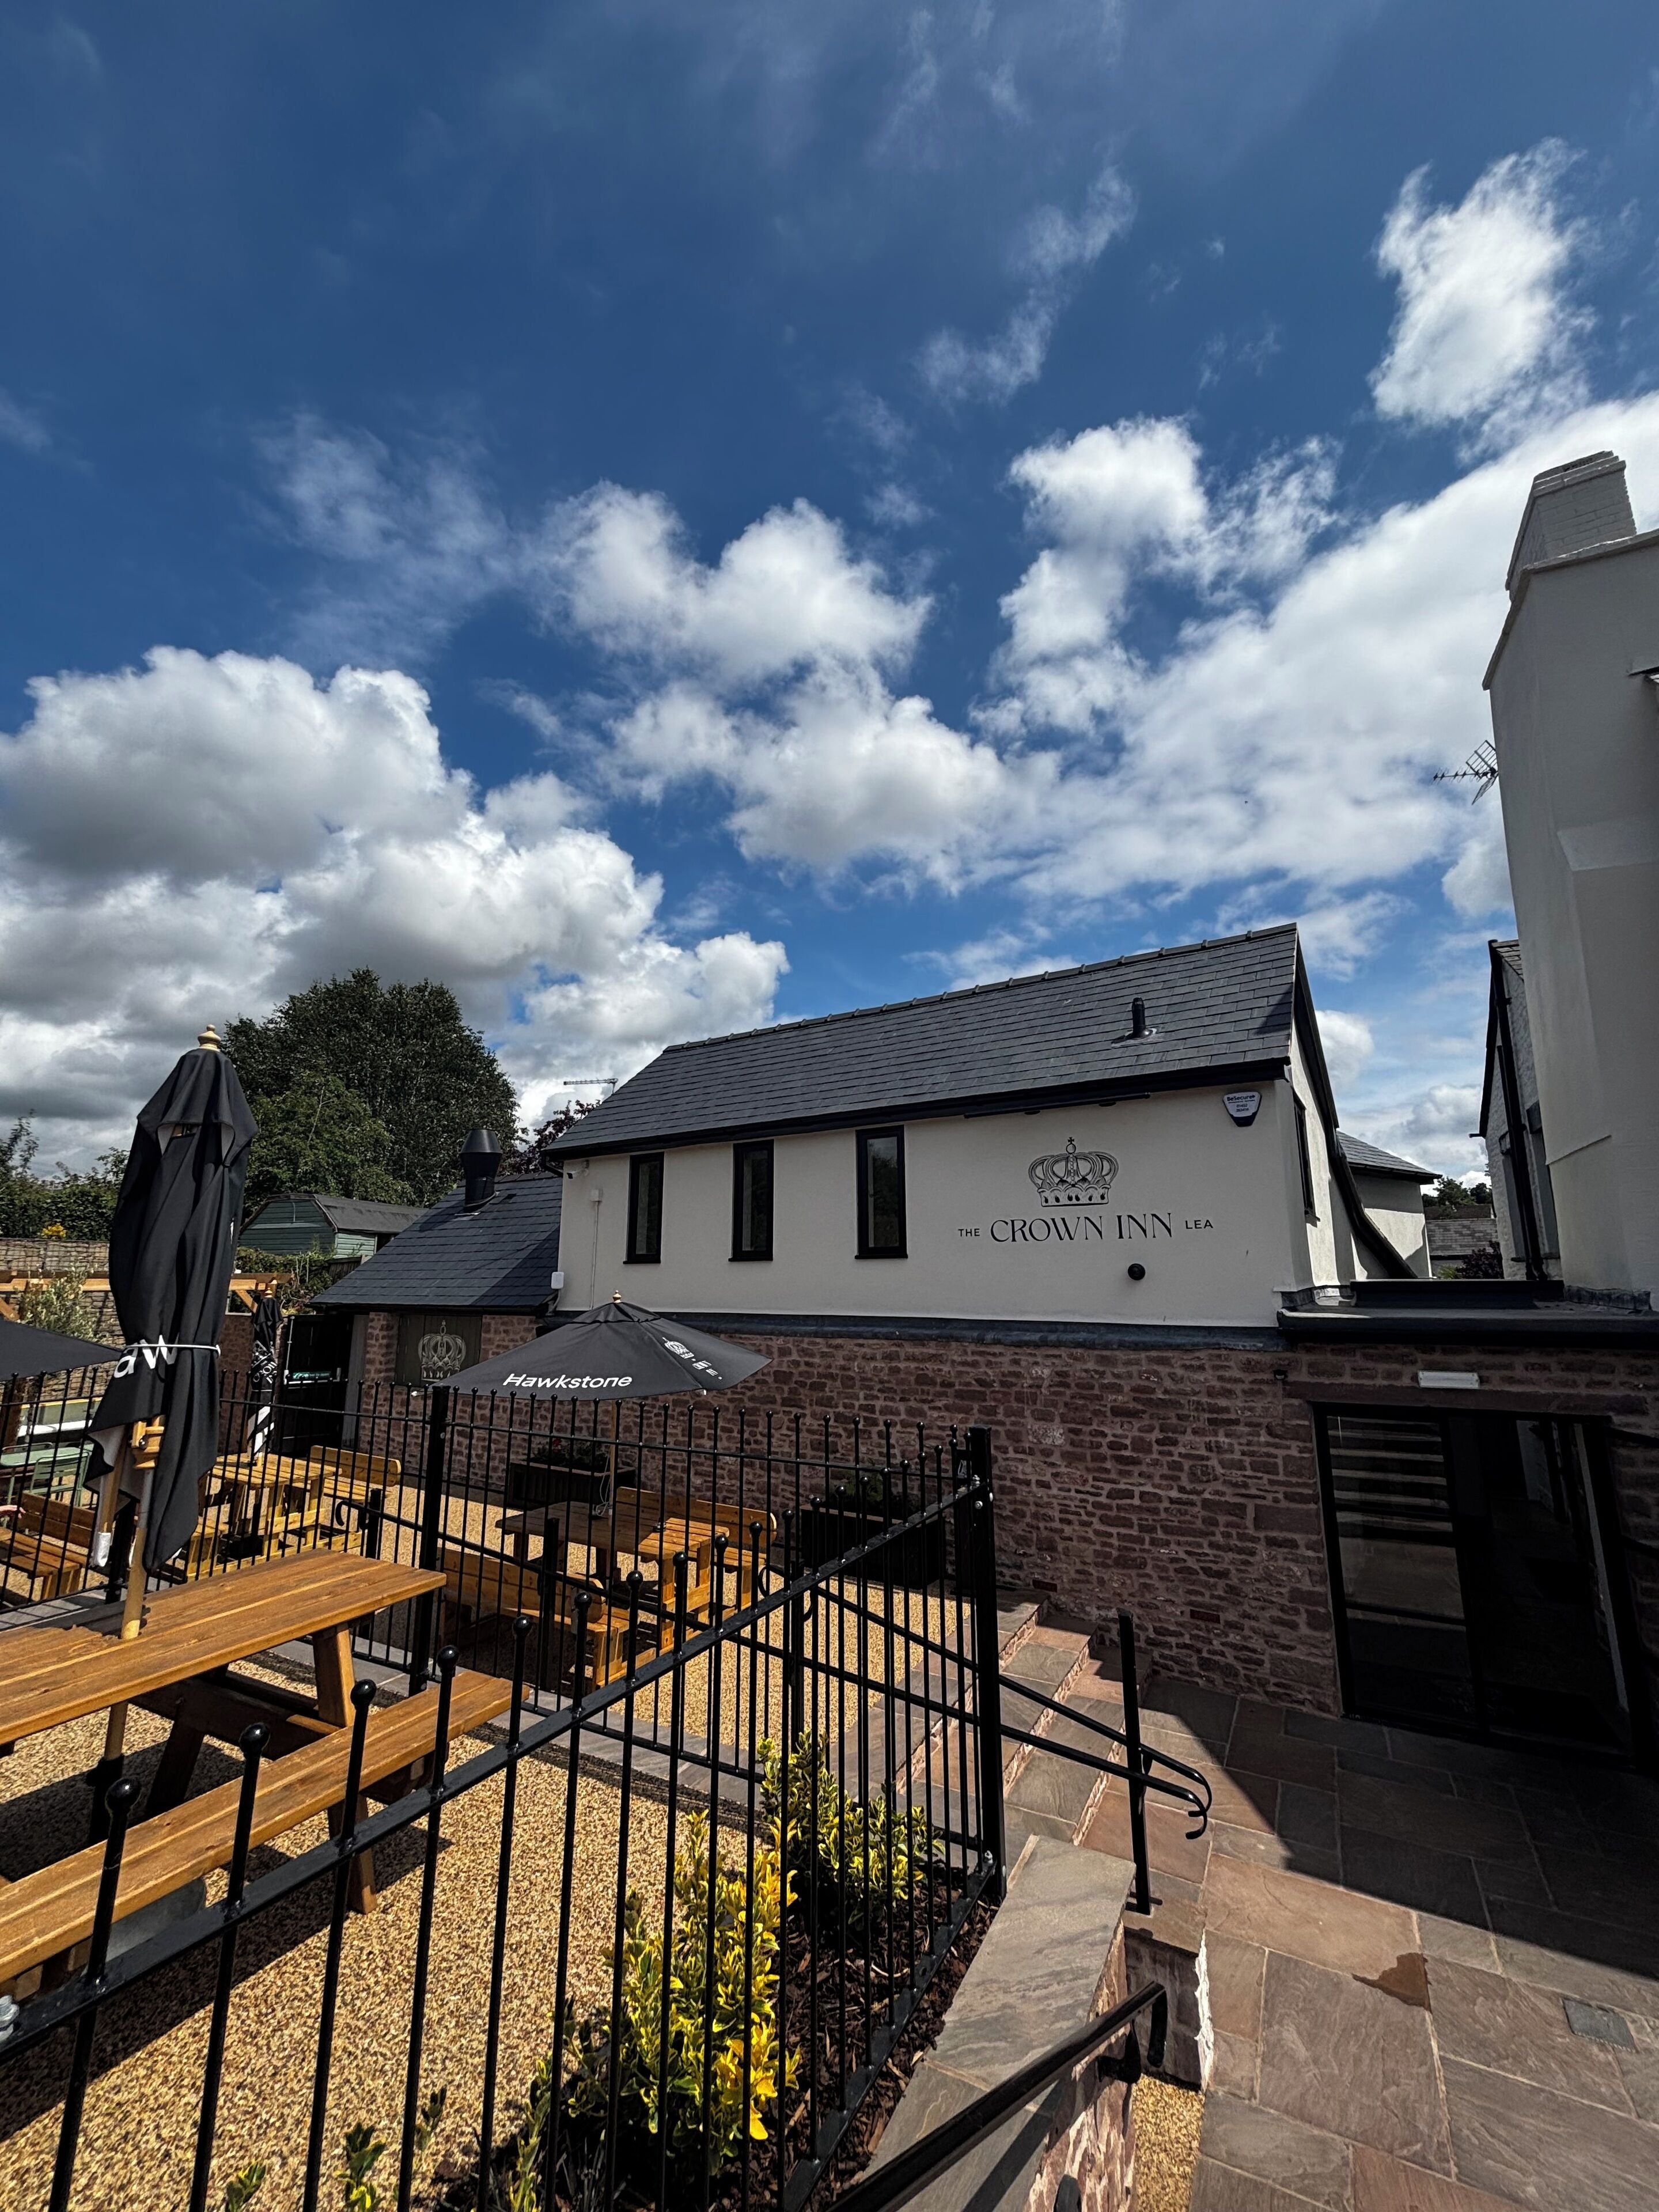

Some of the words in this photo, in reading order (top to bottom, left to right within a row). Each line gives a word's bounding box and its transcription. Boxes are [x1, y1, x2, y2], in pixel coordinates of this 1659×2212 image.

[958, 1228, 980, 1237] THE
[990, 1215, 1104, 1243] CROWN
[1116, 1213, 1173, 1239] INN
[1185, 1219, 1214, 1230] LEA
[502, 1373, 632, 1389] Hawkstone
